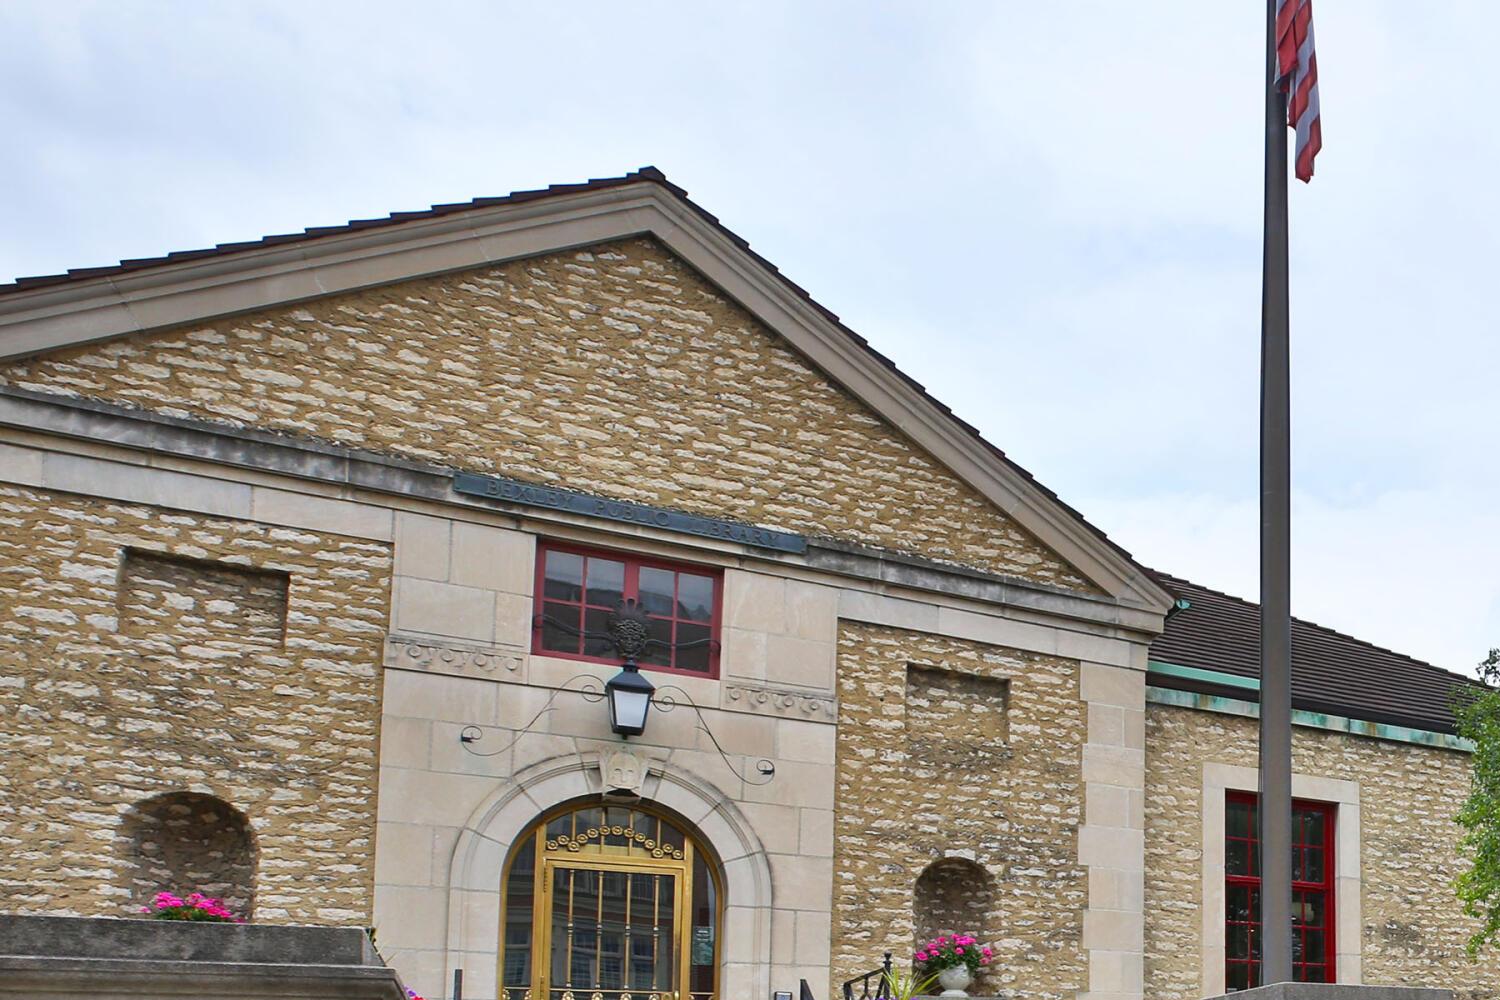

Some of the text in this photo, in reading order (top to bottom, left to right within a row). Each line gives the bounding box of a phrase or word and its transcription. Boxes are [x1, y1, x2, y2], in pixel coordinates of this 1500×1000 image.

[486, 479, 780, 546] BEXLEY PUBLIC LIBRARY
